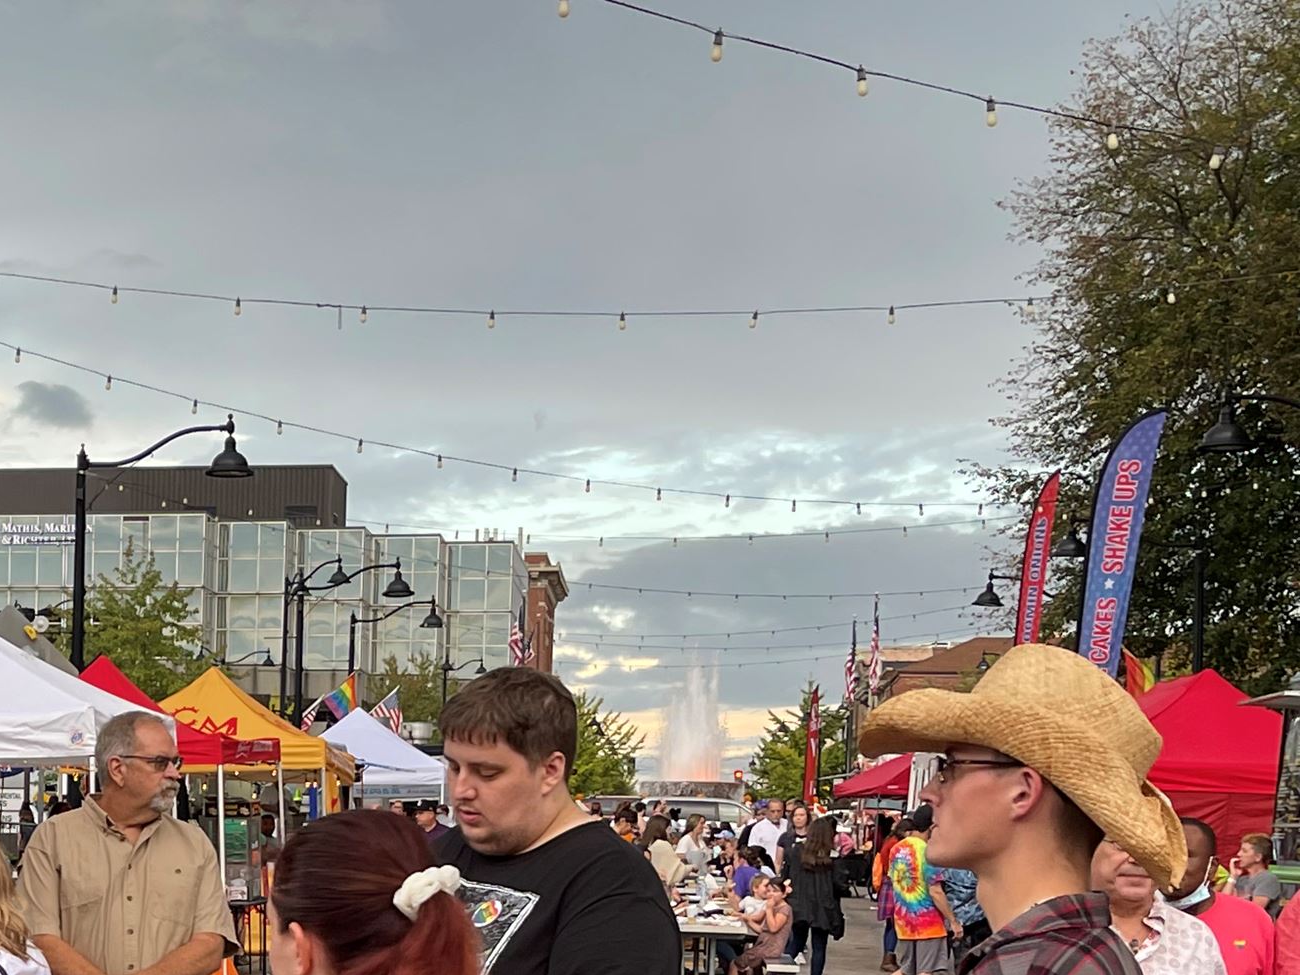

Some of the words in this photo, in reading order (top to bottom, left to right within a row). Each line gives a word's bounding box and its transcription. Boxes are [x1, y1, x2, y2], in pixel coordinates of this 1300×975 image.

[1113, 458, 1142, 502] UPS
[1029, 517, 1048, 582] ONIONS
[1101, 505, 1133, 575] SHAKE
[1023, 586, 1038, 643] OOMIN
[1089, 597, 1117, 665] CAKES
